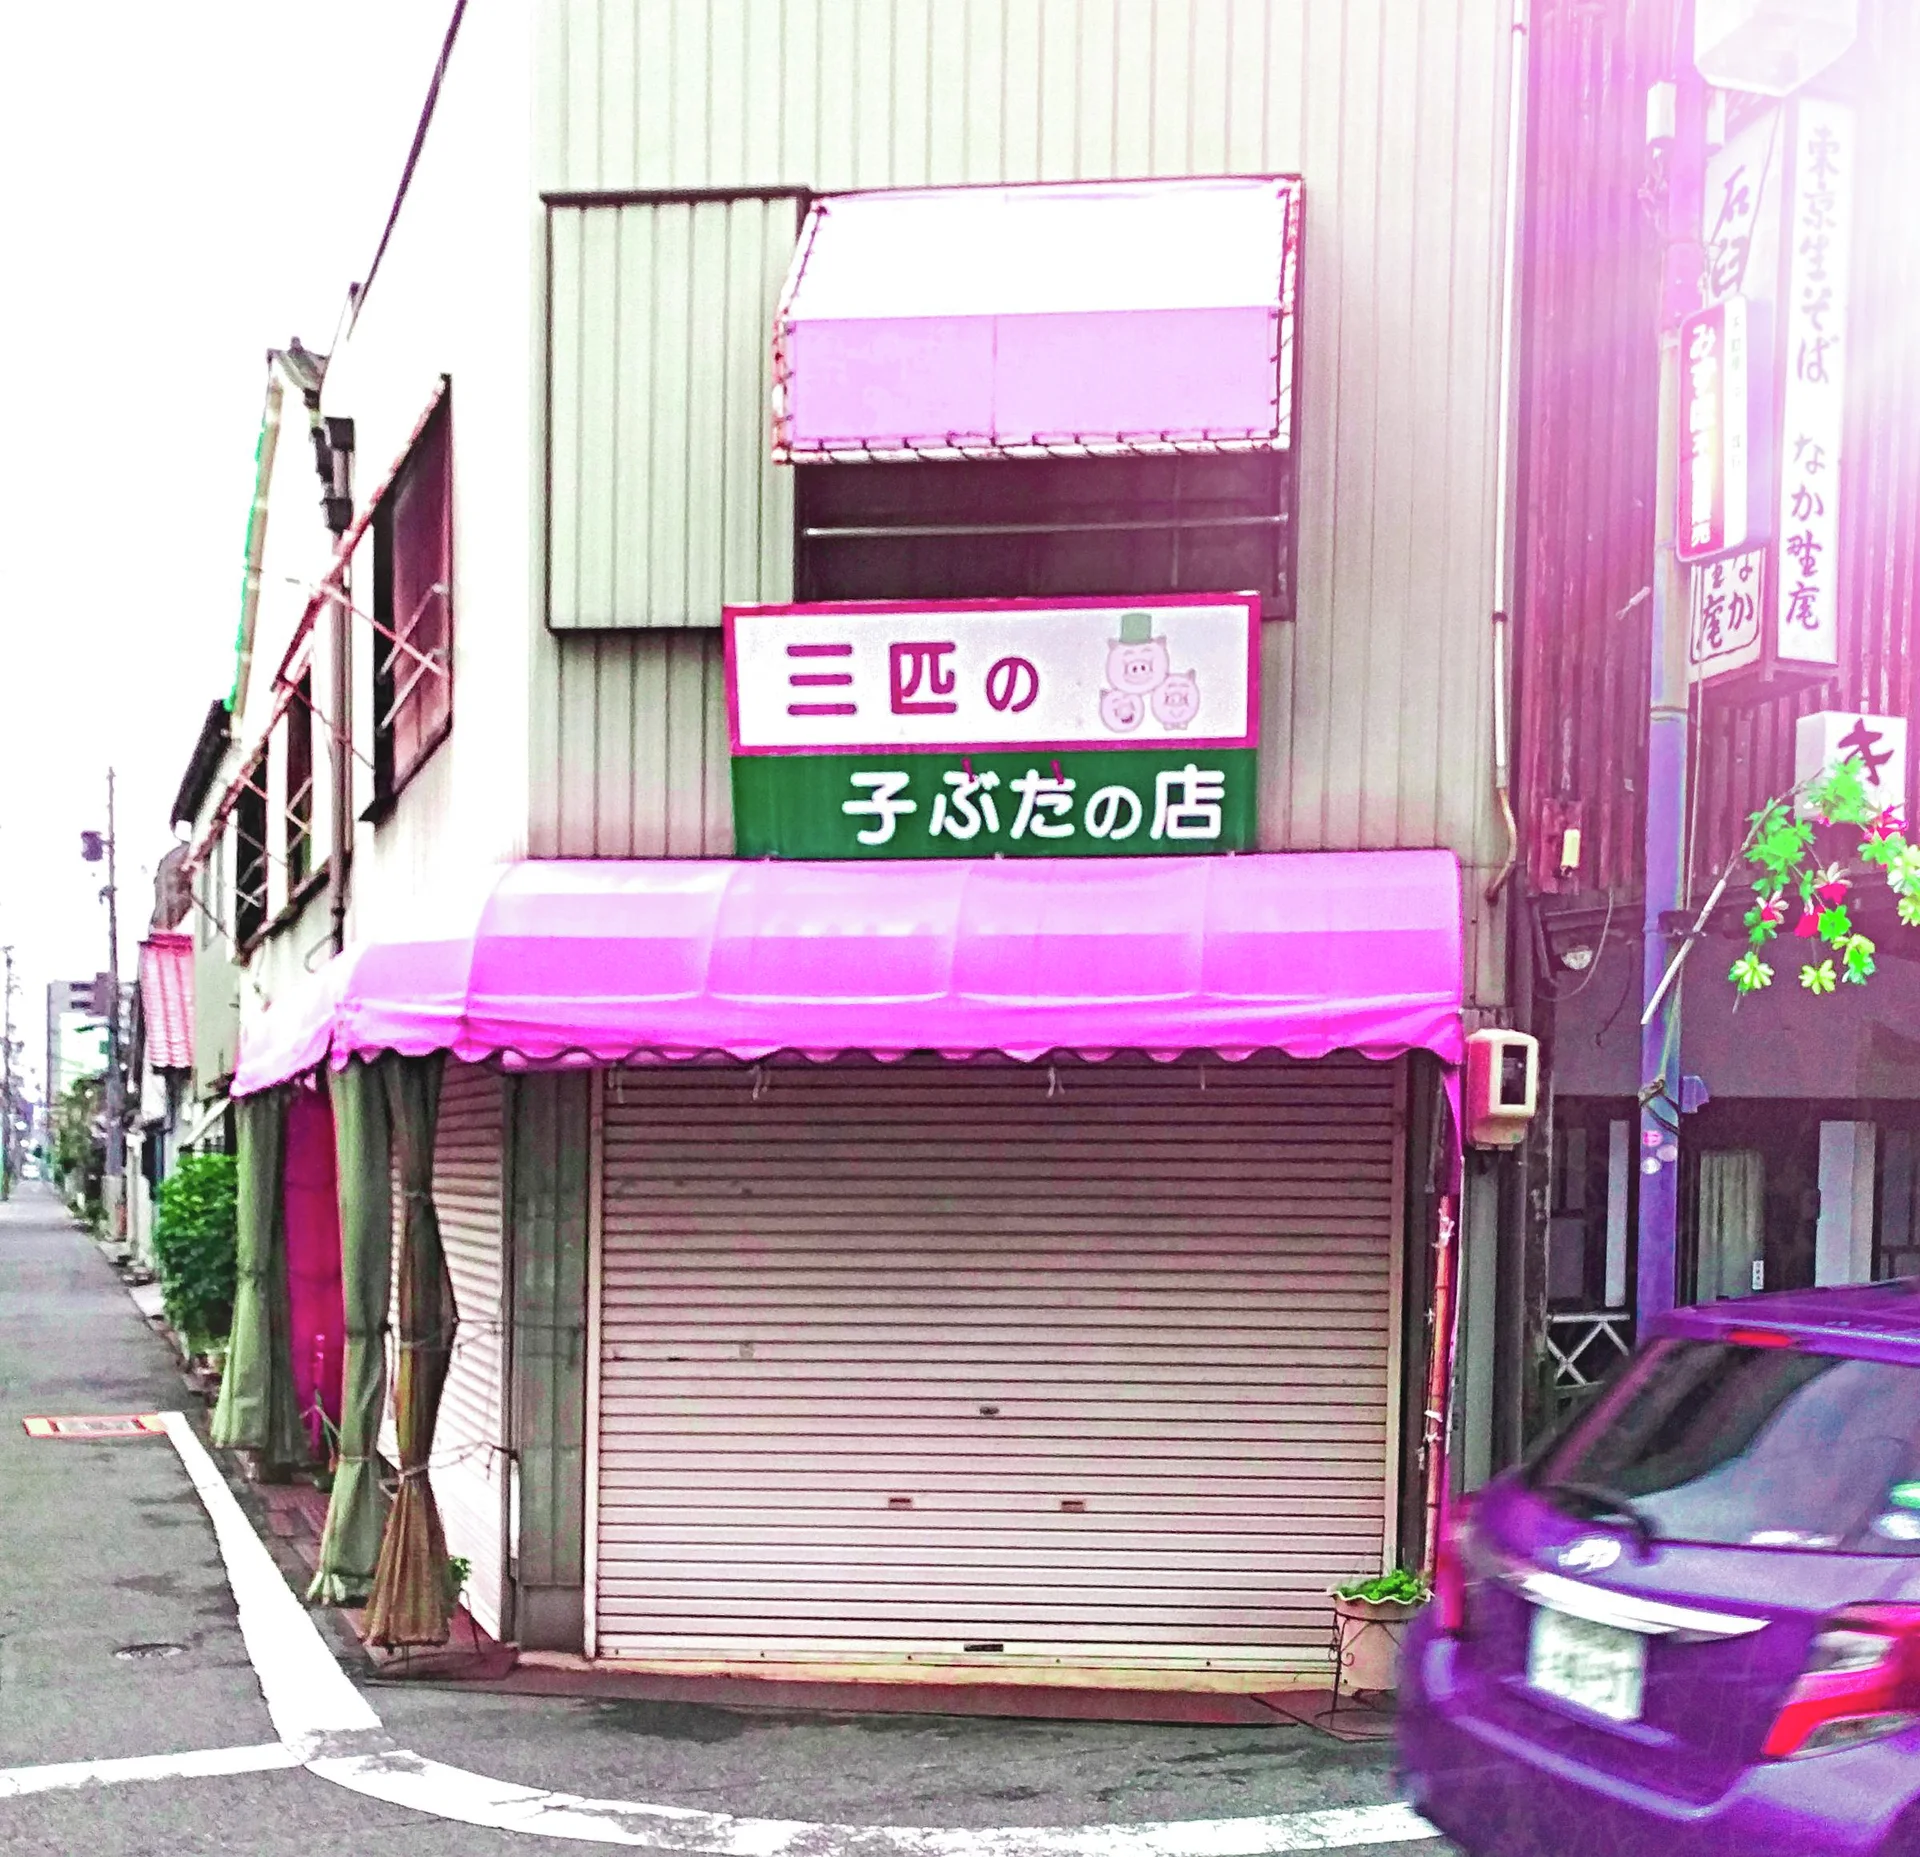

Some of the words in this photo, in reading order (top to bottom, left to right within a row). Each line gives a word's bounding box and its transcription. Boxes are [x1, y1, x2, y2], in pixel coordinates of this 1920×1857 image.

[786, 641, 1040, 716] 三匹の
[841, 763, 1226, 847] 子ぶたの店
